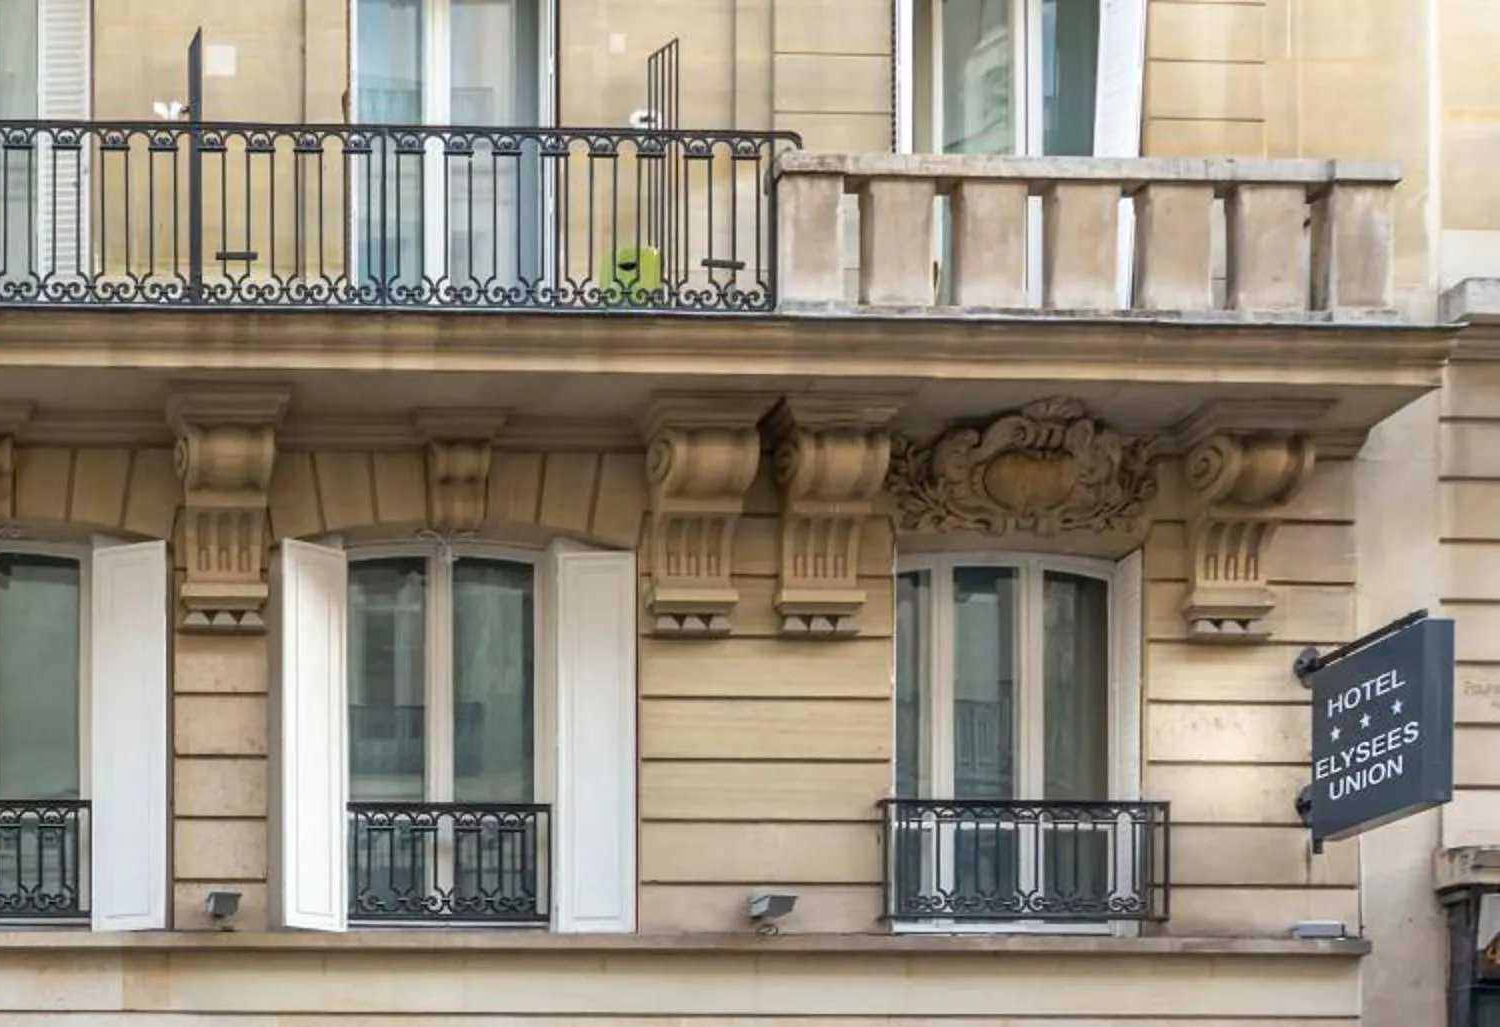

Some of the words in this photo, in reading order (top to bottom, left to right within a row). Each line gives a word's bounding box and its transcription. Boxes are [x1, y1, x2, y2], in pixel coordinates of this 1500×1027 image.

[1327, 669, 1405, 718] HOTEL
[1315, 721, 1419, 780] ELYSEES
[1329, 755, 1404, 801] UNION
